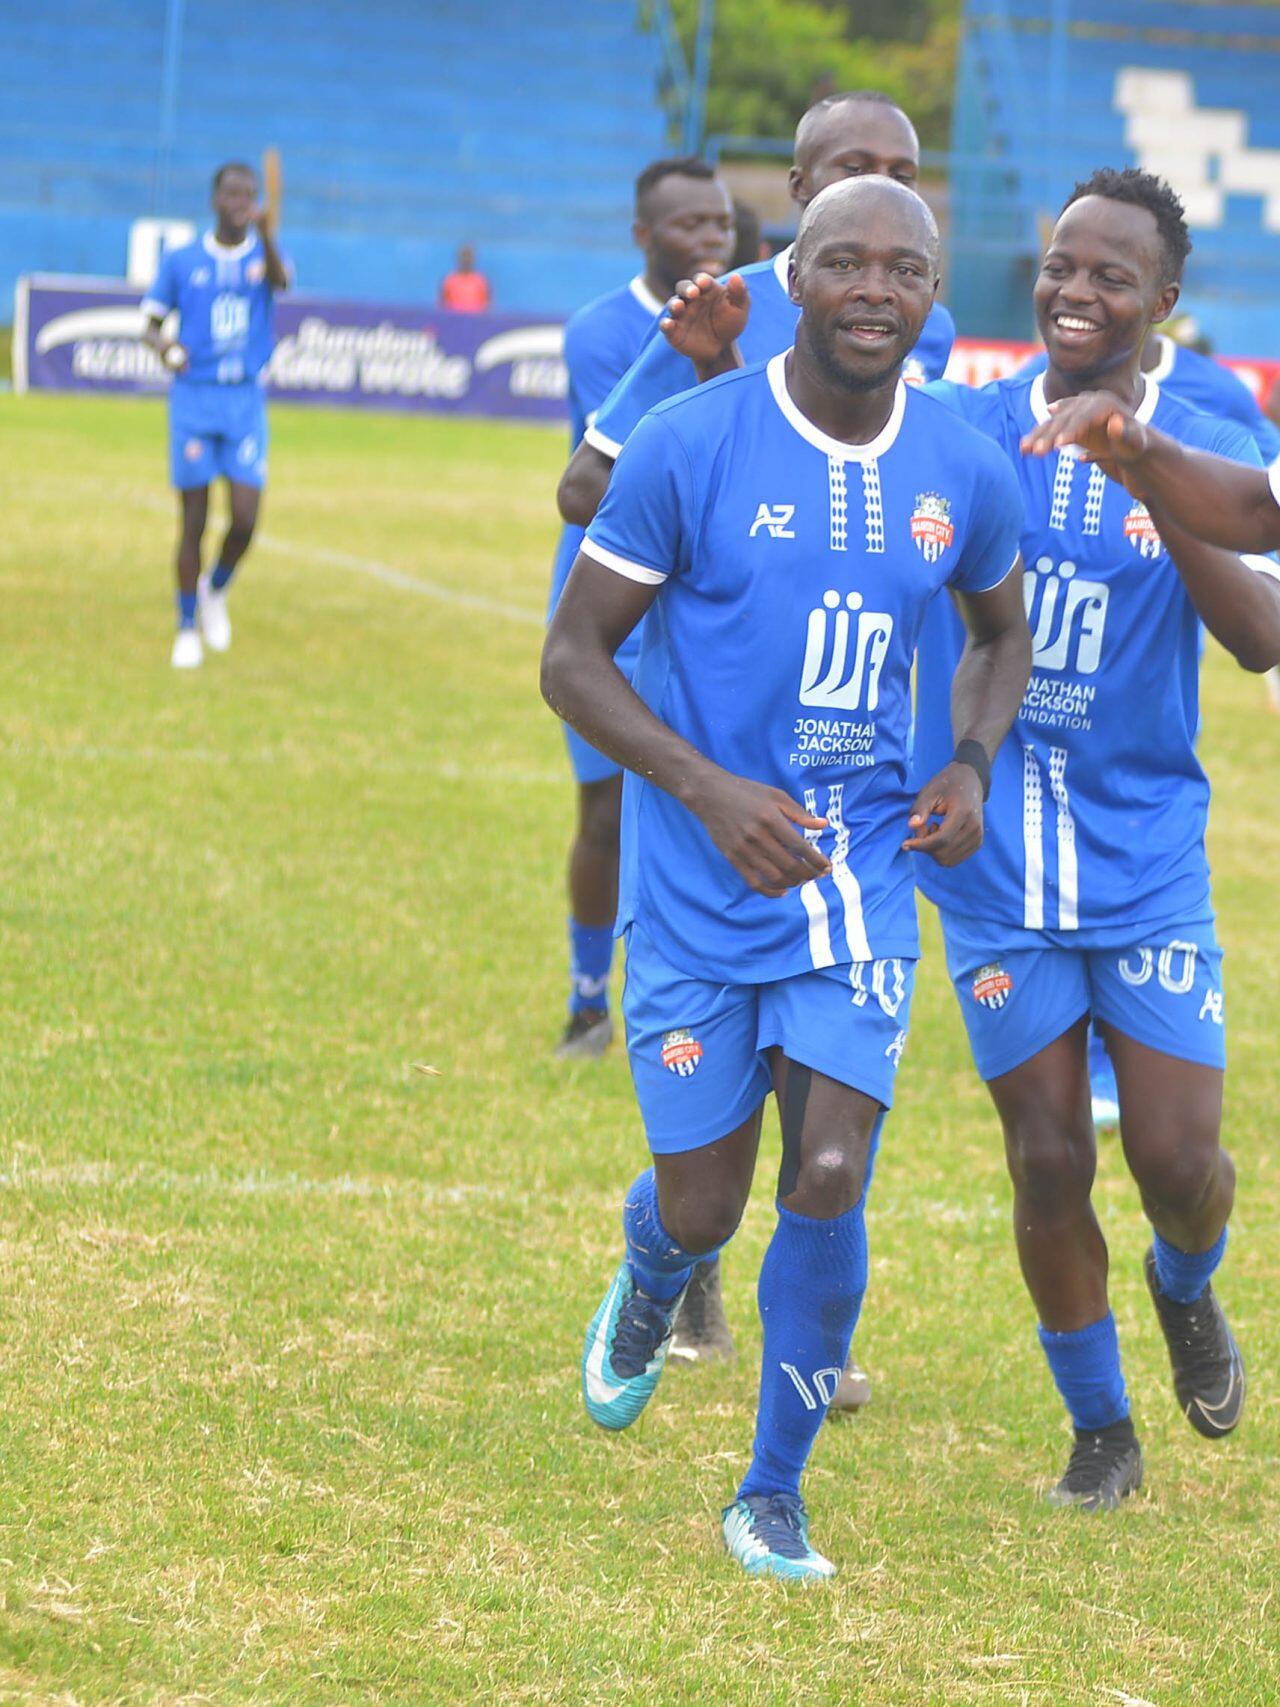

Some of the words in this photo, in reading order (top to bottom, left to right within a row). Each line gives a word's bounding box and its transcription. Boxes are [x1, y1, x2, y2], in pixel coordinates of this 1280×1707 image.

[510, 356, 570, 398] aza
[749, 503, 796, 539] AZ
[1027, 676, 1096, 701] NATHAN
[1023, 692, 1088, 716] CKSON
[1018, 708, 1092, 731] UNDATION
[797, 734, 873, 753] JACKSON
[789, 753, 875, 767] FOUNDATION
[884, 1028, 907, 1070] A
[779, 1361, 842, 1411] 10
